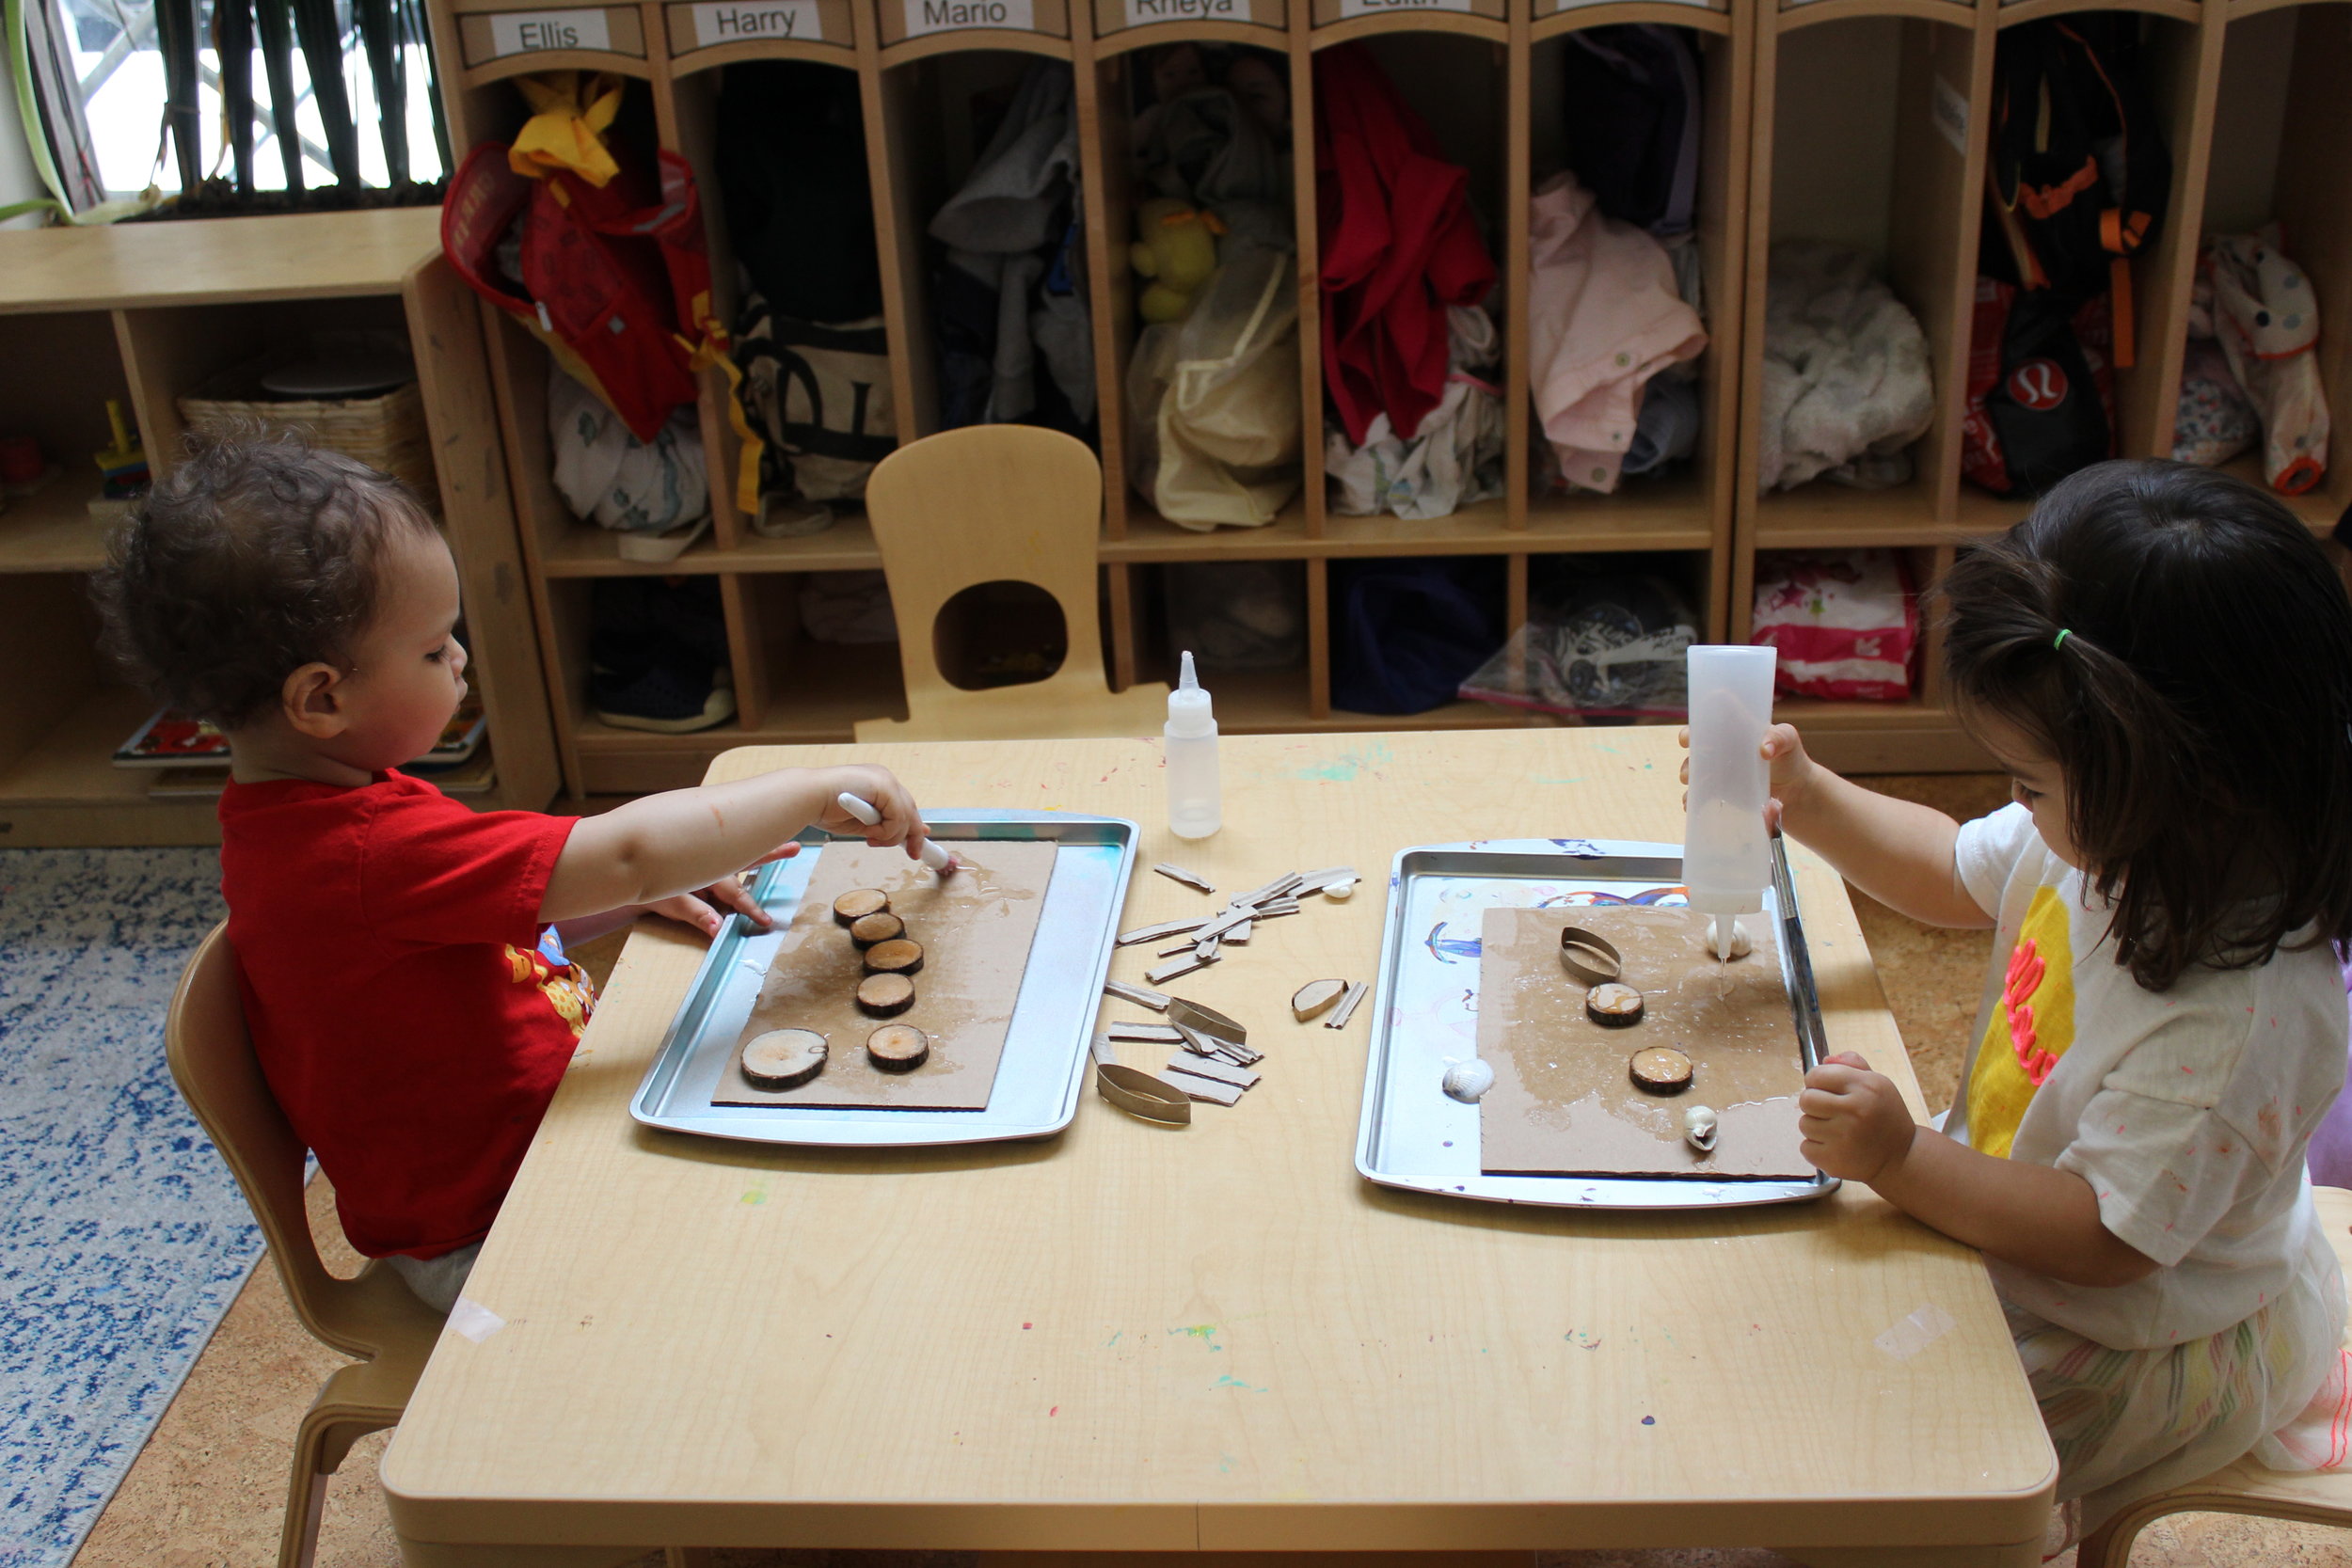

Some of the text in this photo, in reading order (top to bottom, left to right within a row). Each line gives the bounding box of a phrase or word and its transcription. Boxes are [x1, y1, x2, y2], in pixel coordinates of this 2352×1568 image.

[716, 8, 797, 38] Harry
[923, 0, 1007, 25] Mario
[518, 21, 579, 48] Ellis
